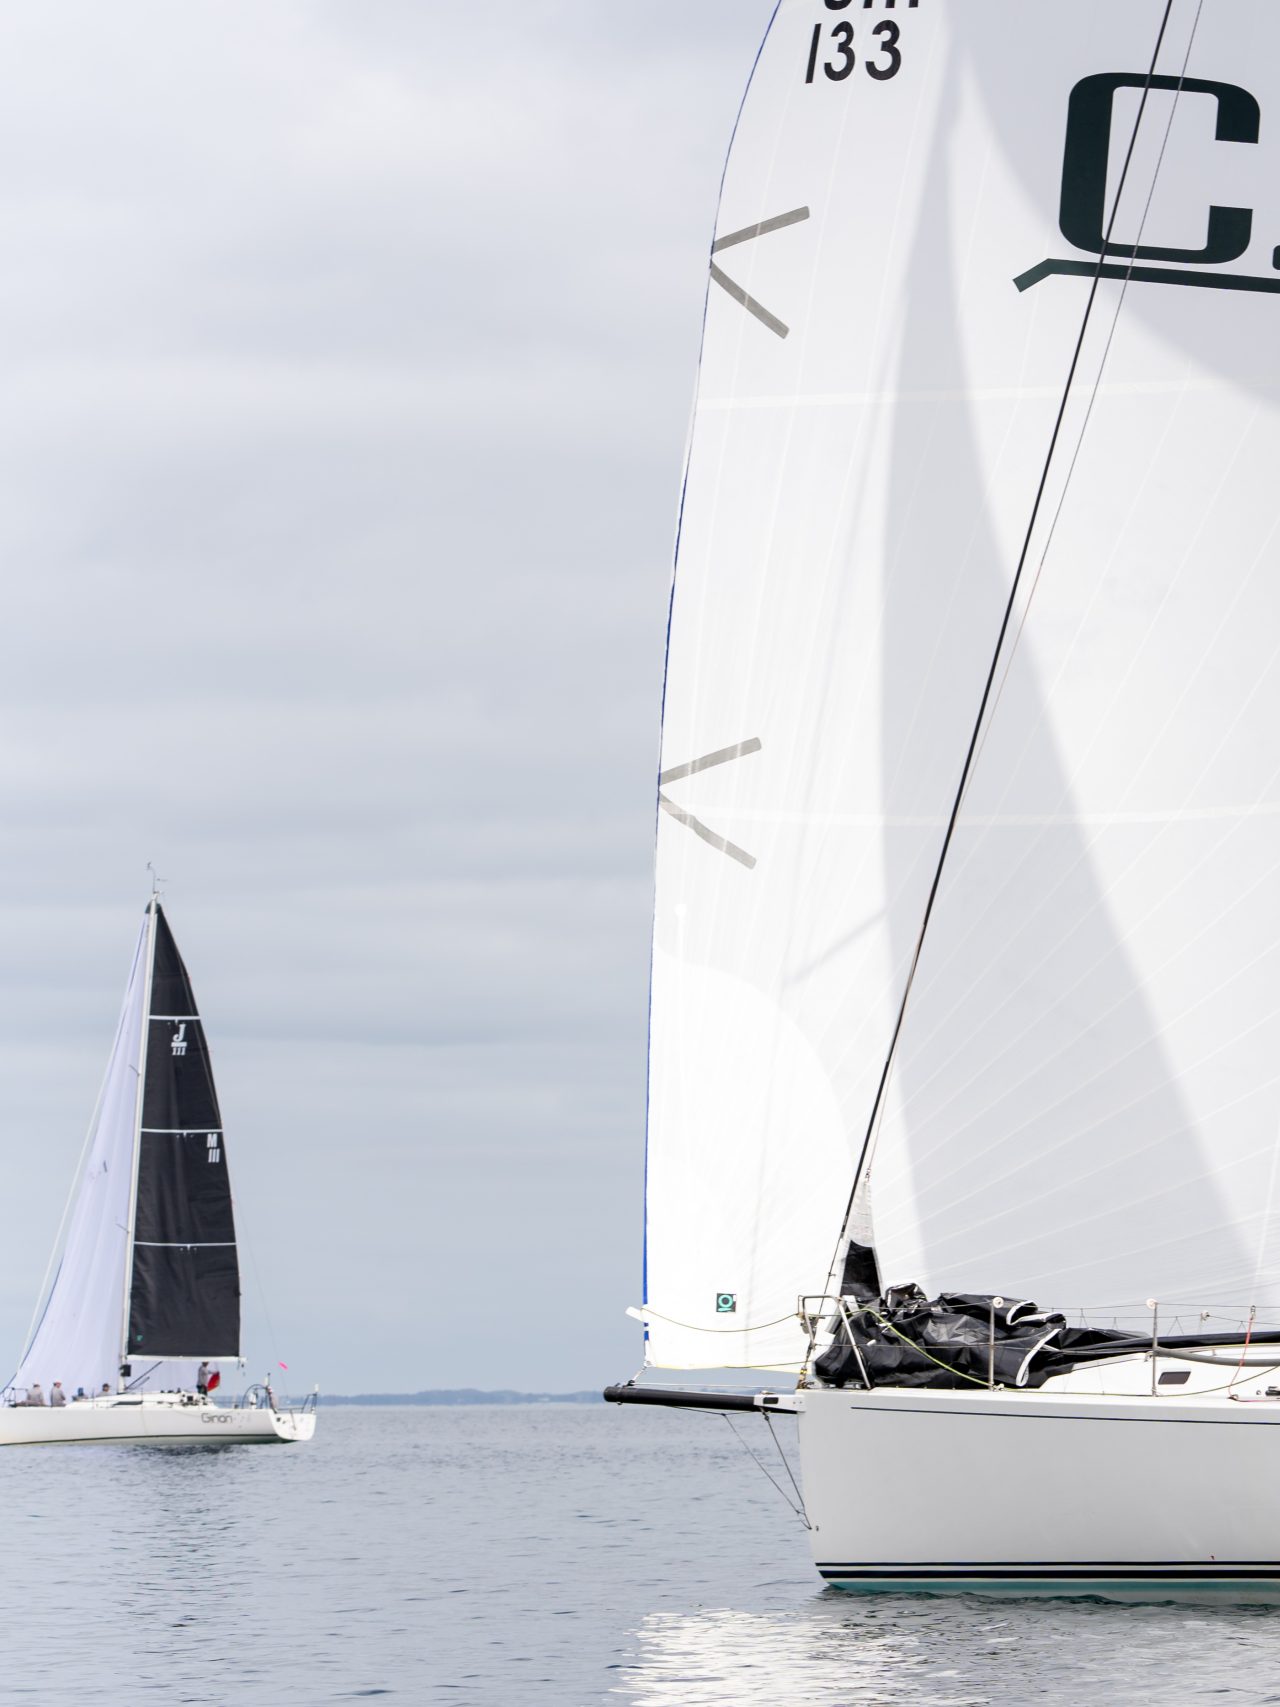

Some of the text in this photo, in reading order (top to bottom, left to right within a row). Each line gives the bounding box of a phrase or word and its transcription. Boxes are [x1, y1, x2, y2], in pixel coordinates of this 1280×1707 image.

[804, 19, 902, 84] 133
[173, 1023, 187, 1042] J
[206, 1133, 218, 1148] M
